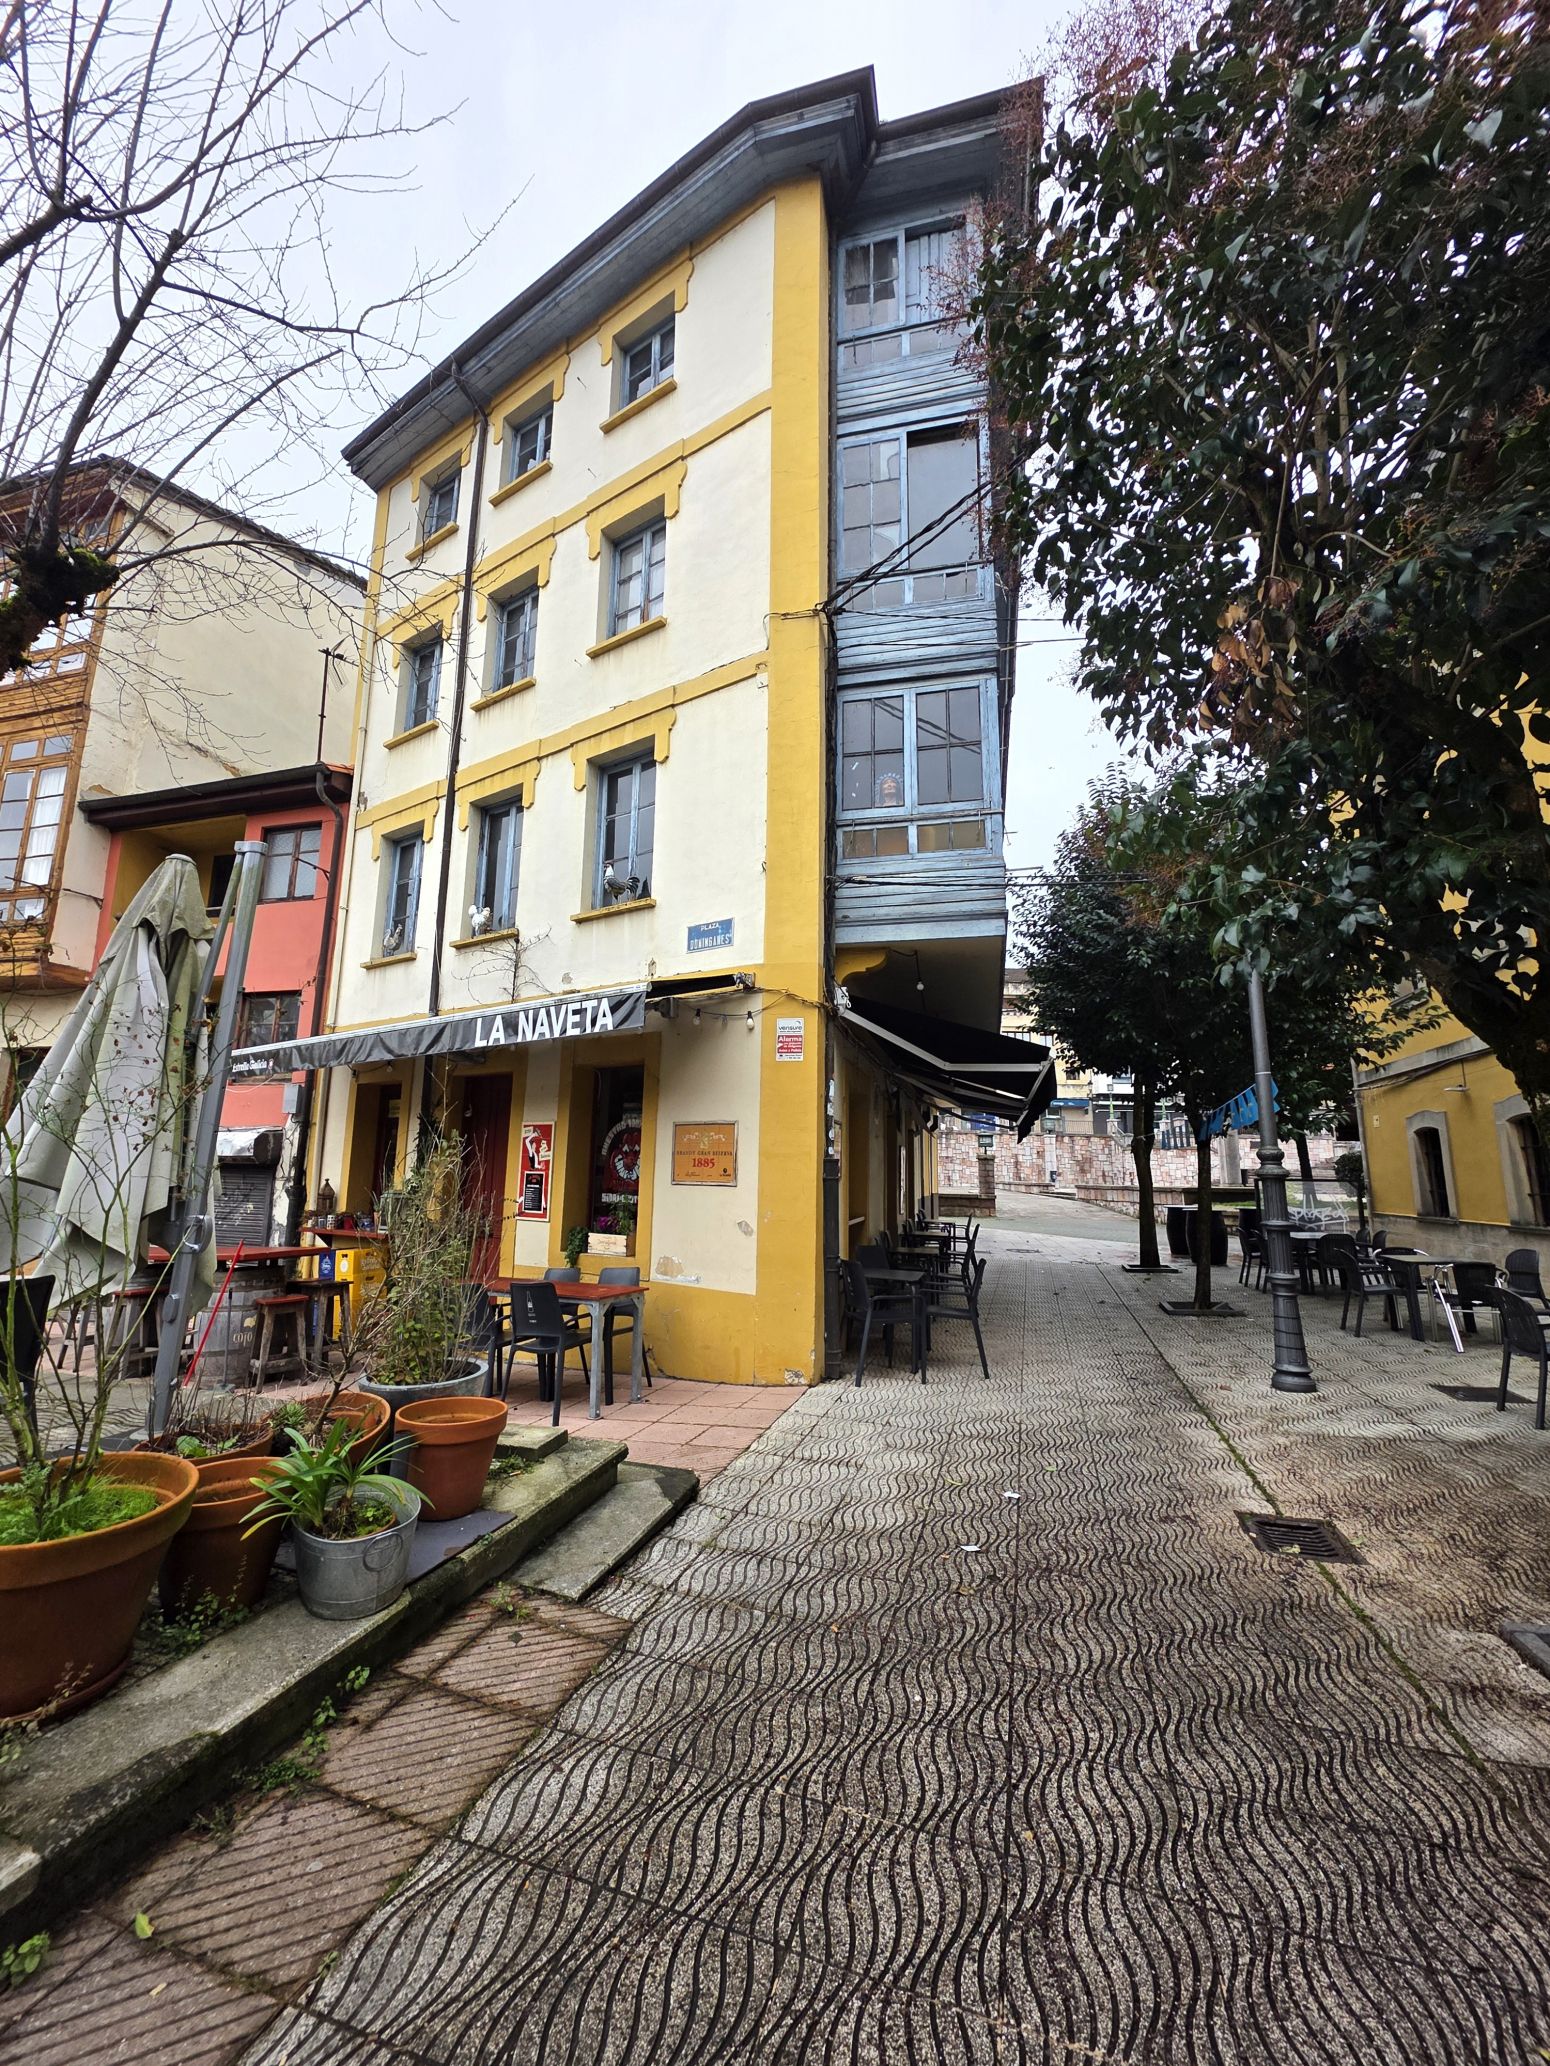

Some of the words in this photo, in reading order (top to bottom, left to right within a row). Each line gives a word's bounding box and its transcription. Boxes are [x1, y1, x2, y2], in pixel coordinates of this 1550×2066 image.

[700, 923, 719, 931] PLAZA
[474, 1014, 506, 1047] LA
[517, 998, 613, 1042] NAVETA
[692, 1157, 716, 1169] 1885
